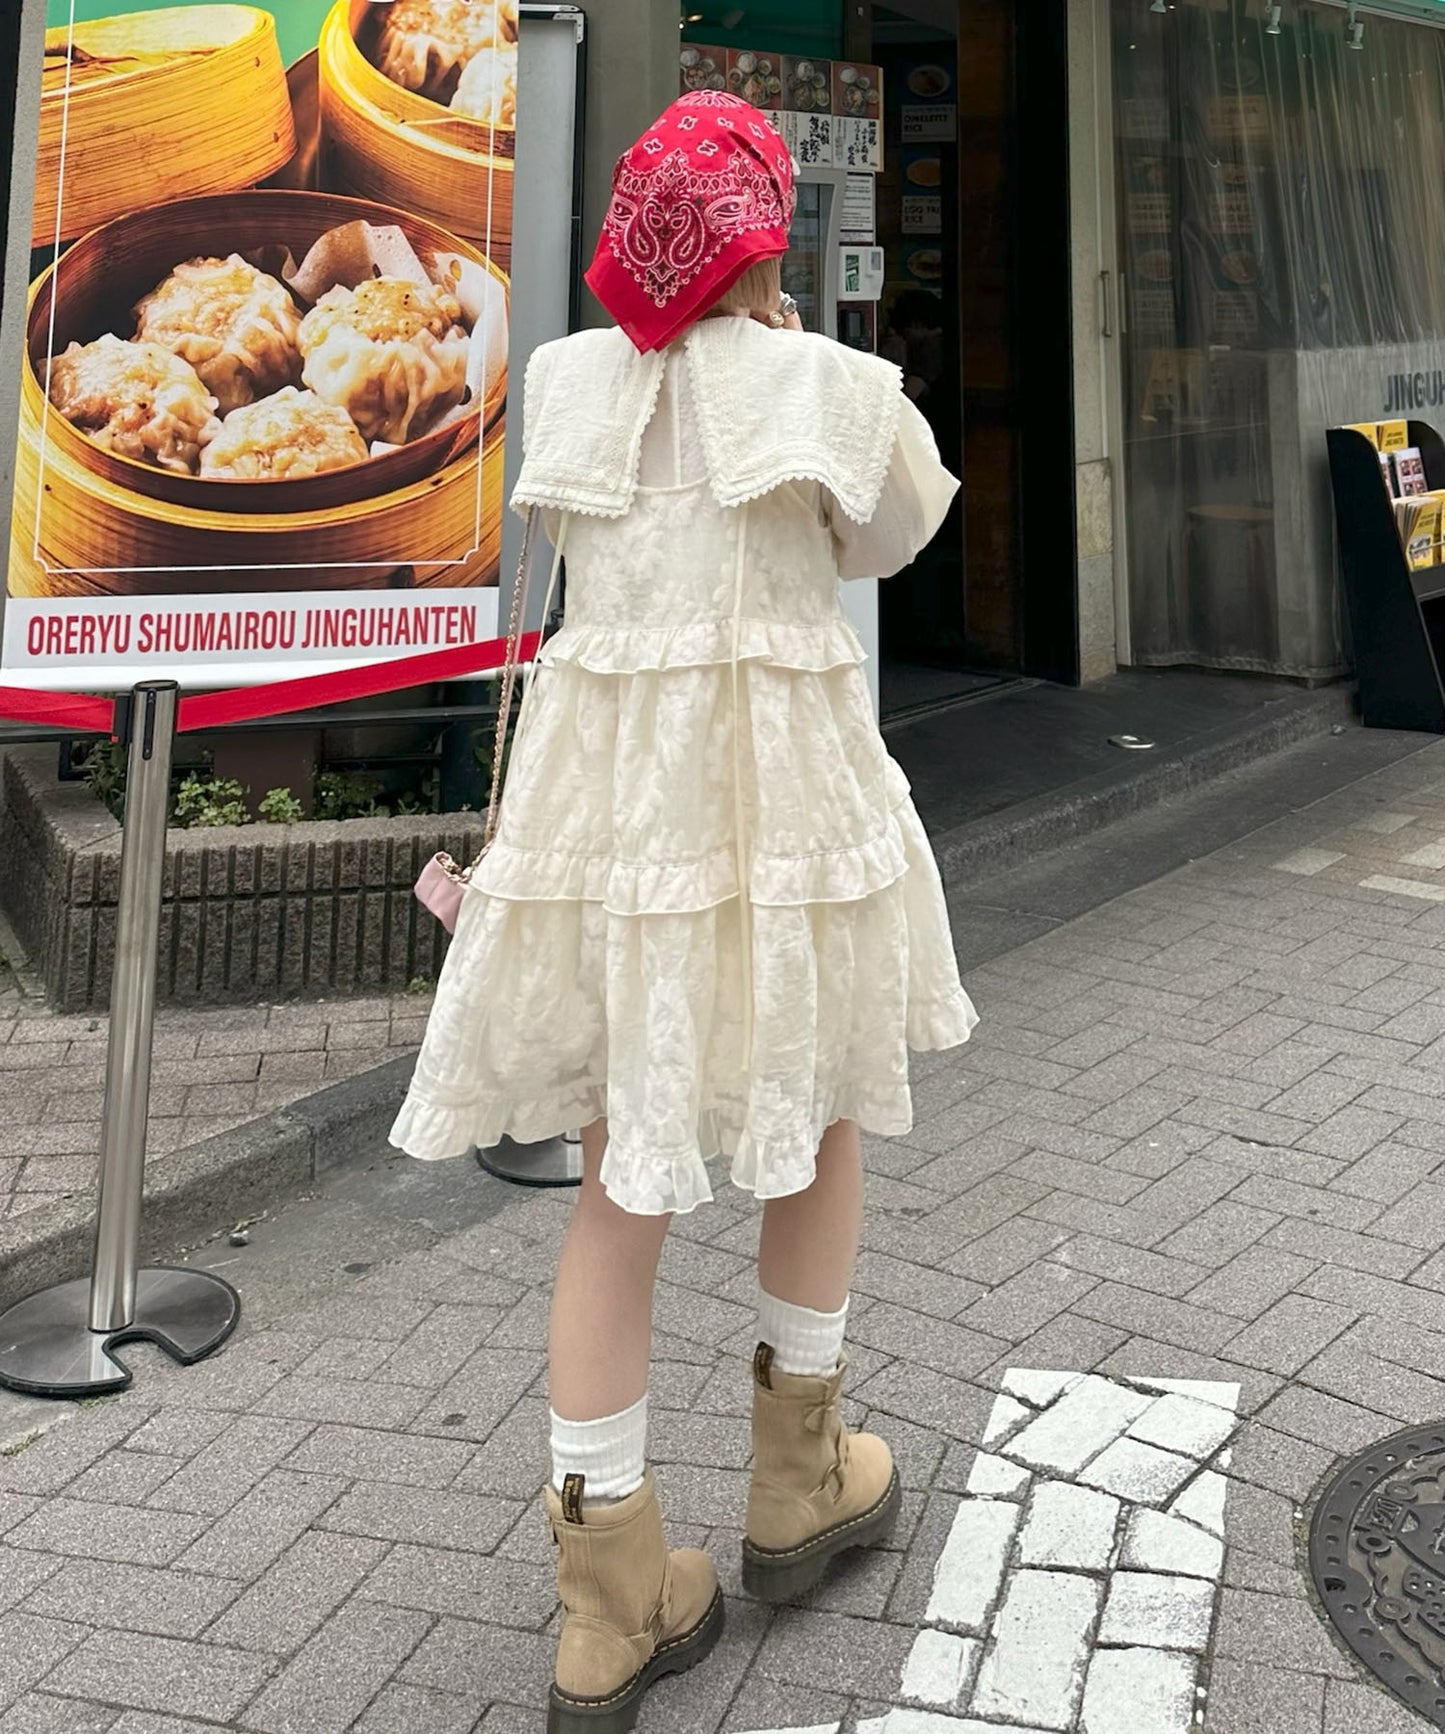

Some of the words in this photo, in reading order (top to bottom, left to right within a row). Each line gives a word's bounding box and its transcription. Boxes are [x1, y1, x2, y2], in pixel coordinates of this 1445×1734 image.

[27, 615, 131, 656] ORERYU
[137, 610, 296, 653] SHUMAIROU
[301, 605, 477, 649] JINGUHANTEN
